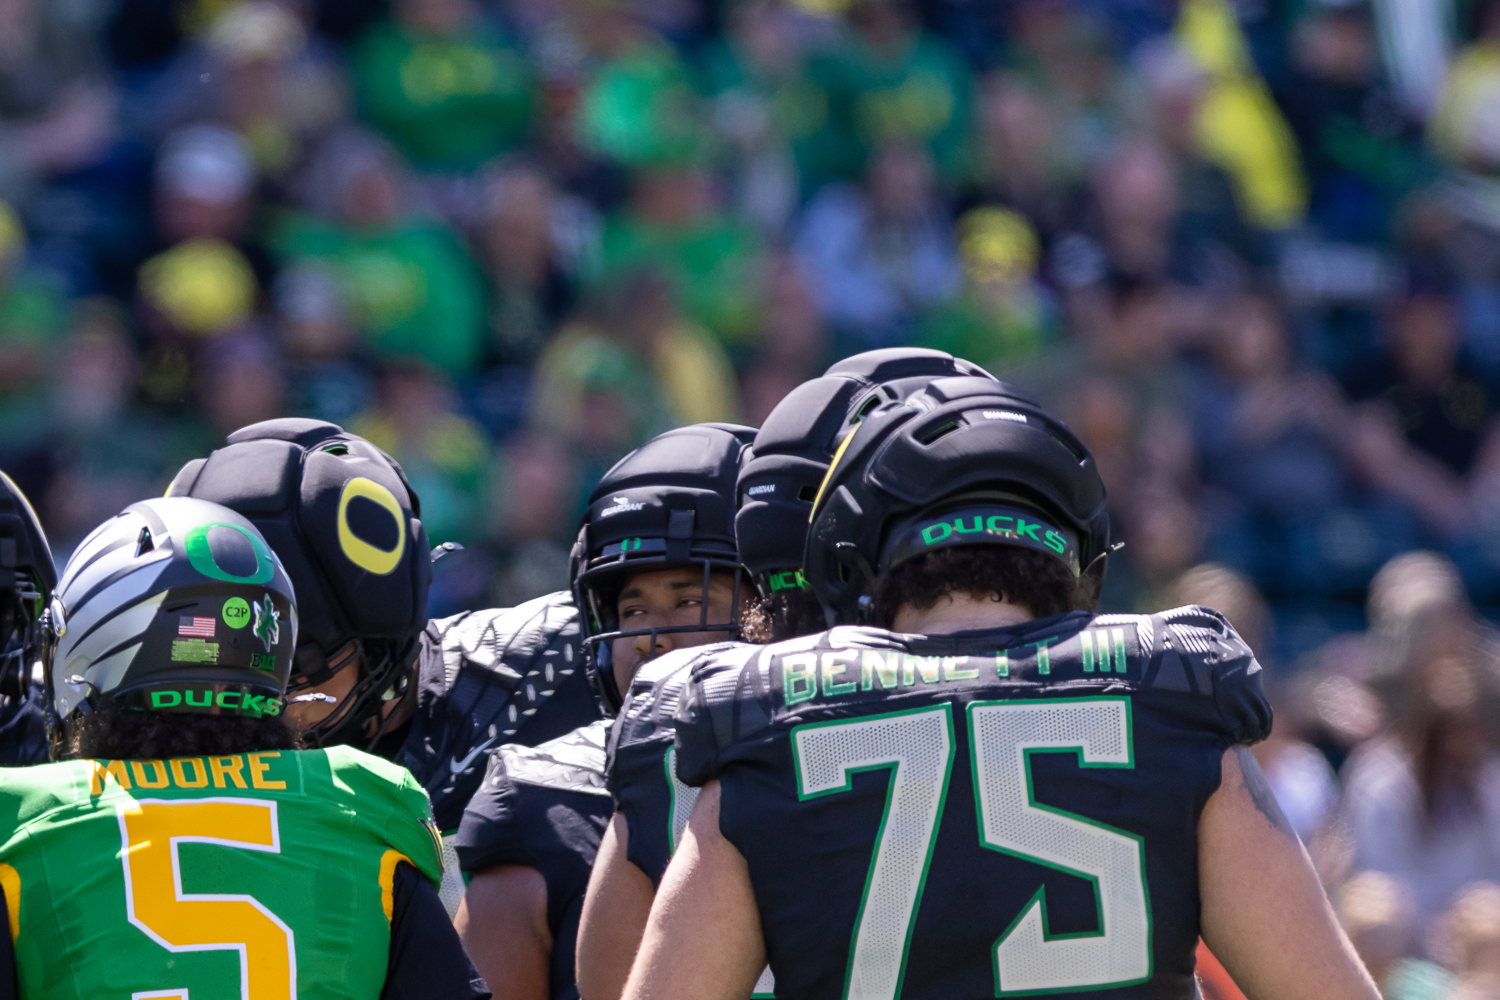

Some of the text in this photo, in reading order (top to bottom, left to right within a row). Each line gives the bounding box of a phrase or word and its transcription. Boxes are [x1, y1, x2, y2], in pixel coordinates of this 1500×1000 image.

[336, 476, 404, 575] O
[921, 515, 1067, 554] DUCKS
[185, 521, 274, 584] O
[225, 606, 248, 618] C2P
[151, 690, 283, 716] DUCKS
[82, 752, 287, 796] MOORE
